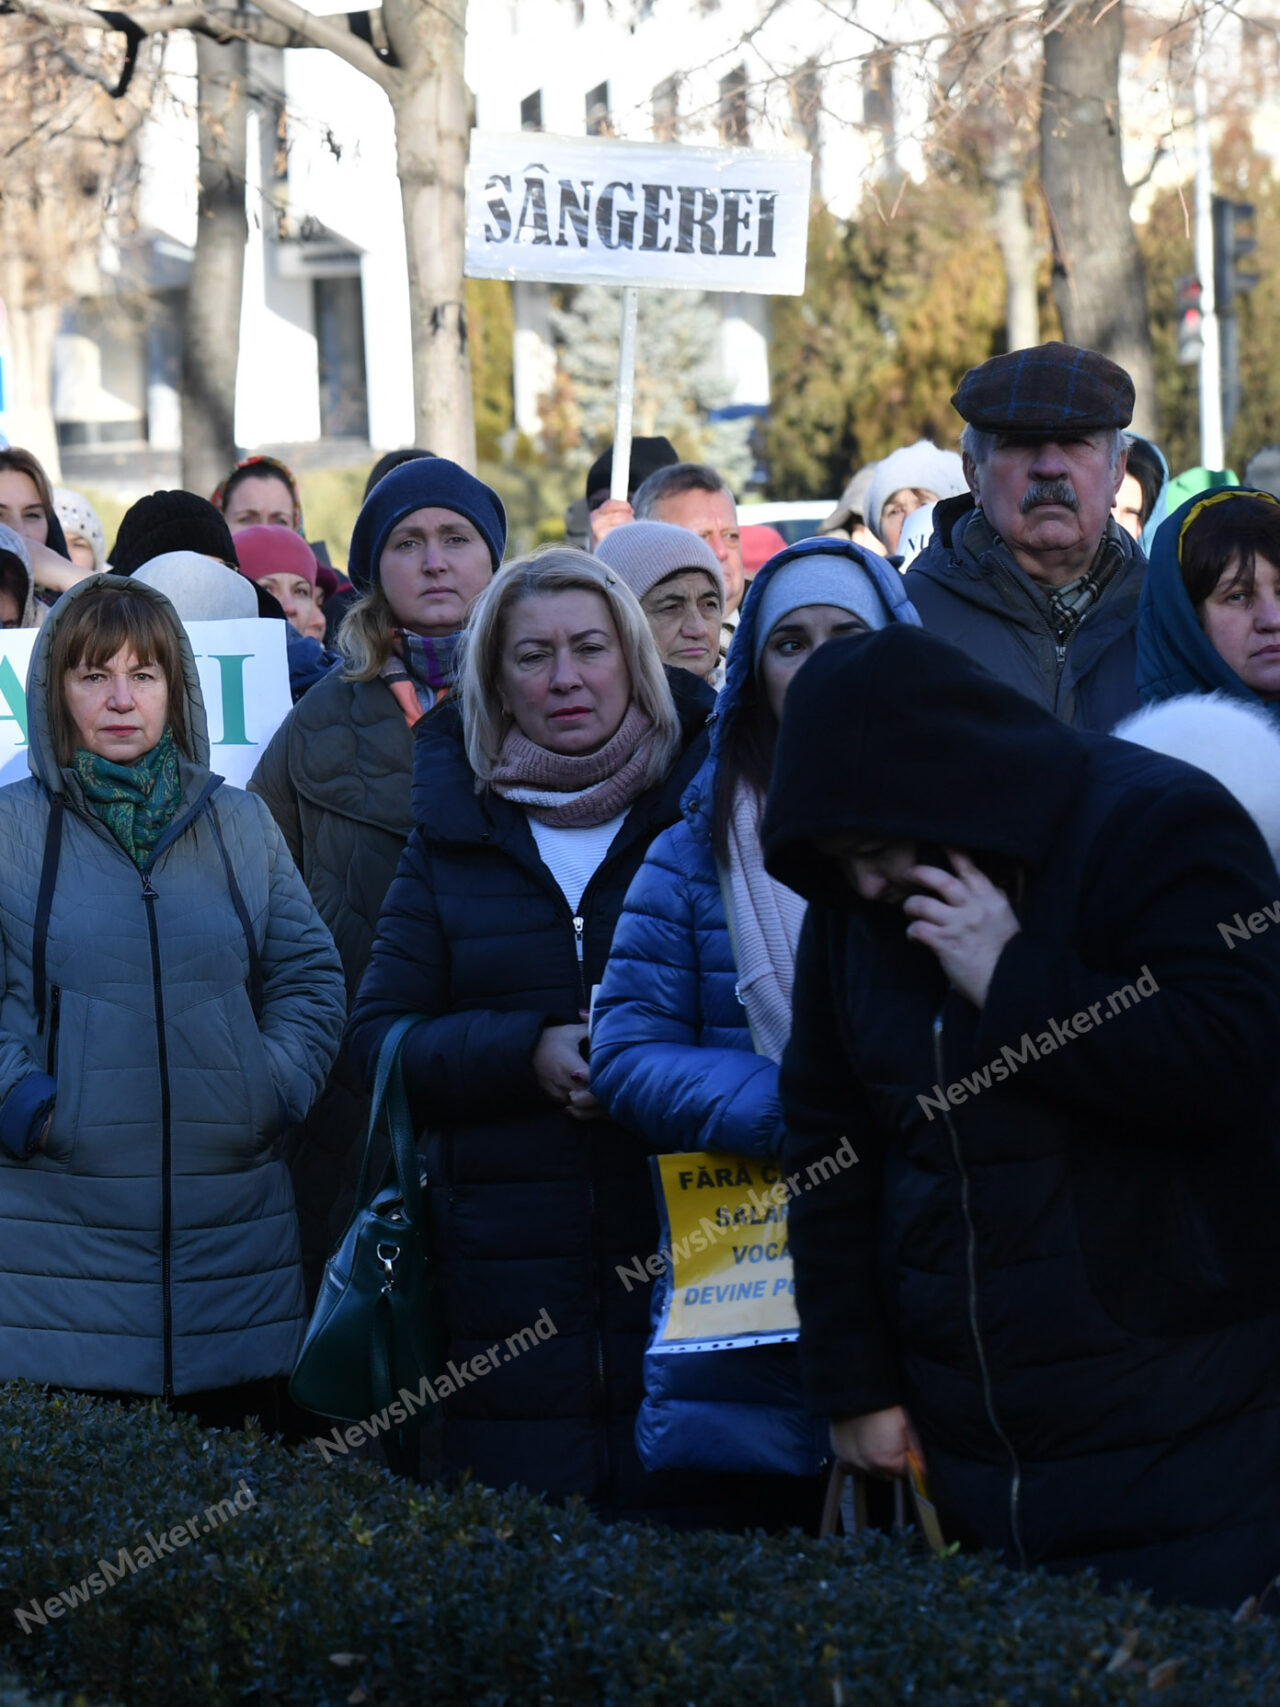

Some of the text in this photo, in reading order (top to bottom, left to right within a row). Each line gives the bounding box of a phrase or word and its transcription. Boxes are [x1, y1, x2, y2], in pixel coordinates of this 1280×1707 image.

[484, 163, 779, 258] SÂNGEREI
[678, 1163, 754, 1190] FĂRĂ
[684, 1280, 767, 1306] DEVINE
